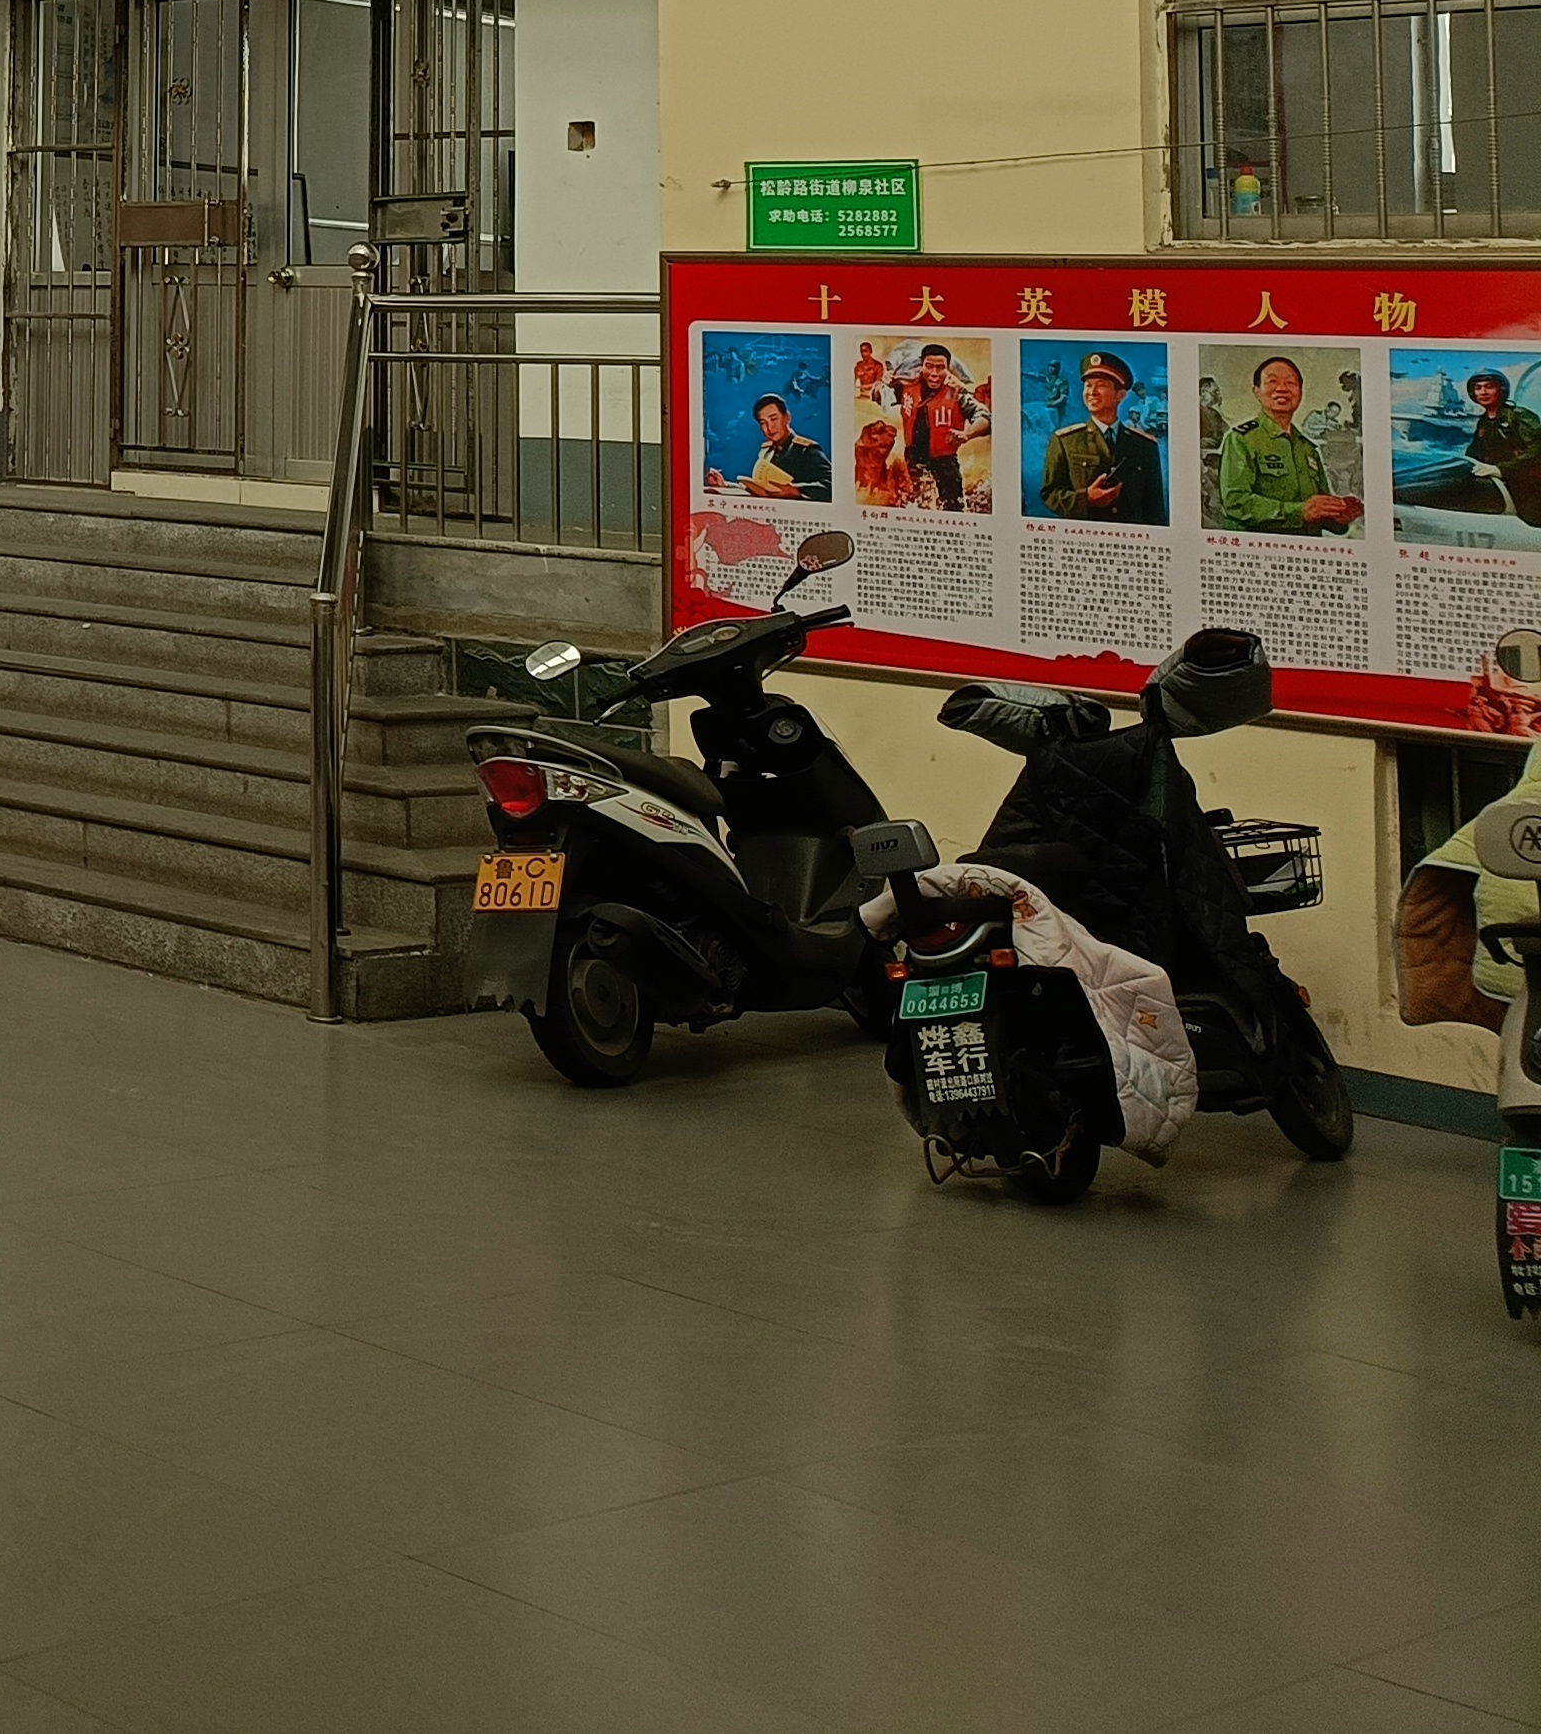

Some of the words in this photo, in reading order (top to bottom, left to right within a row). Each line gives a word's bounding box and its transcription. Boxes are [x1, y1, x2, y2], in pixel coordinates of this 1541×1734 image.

[760, 178, 906, 197] 松龄路街道柳泉社区
[838, 210, 898, 222] 5282882
[838, 225, 899, 237] 2568577
[808, 284, 1417, 333] 十大英模人物
[1206, 535, 1242, 547] 林俊德
[478, 881, 555, 906] 8061D
[907, 992, 980, 1014] 0044653
[917, 1020, 986, 1051] 烨鑫
[923, 1046, 990, 1076] 车行
